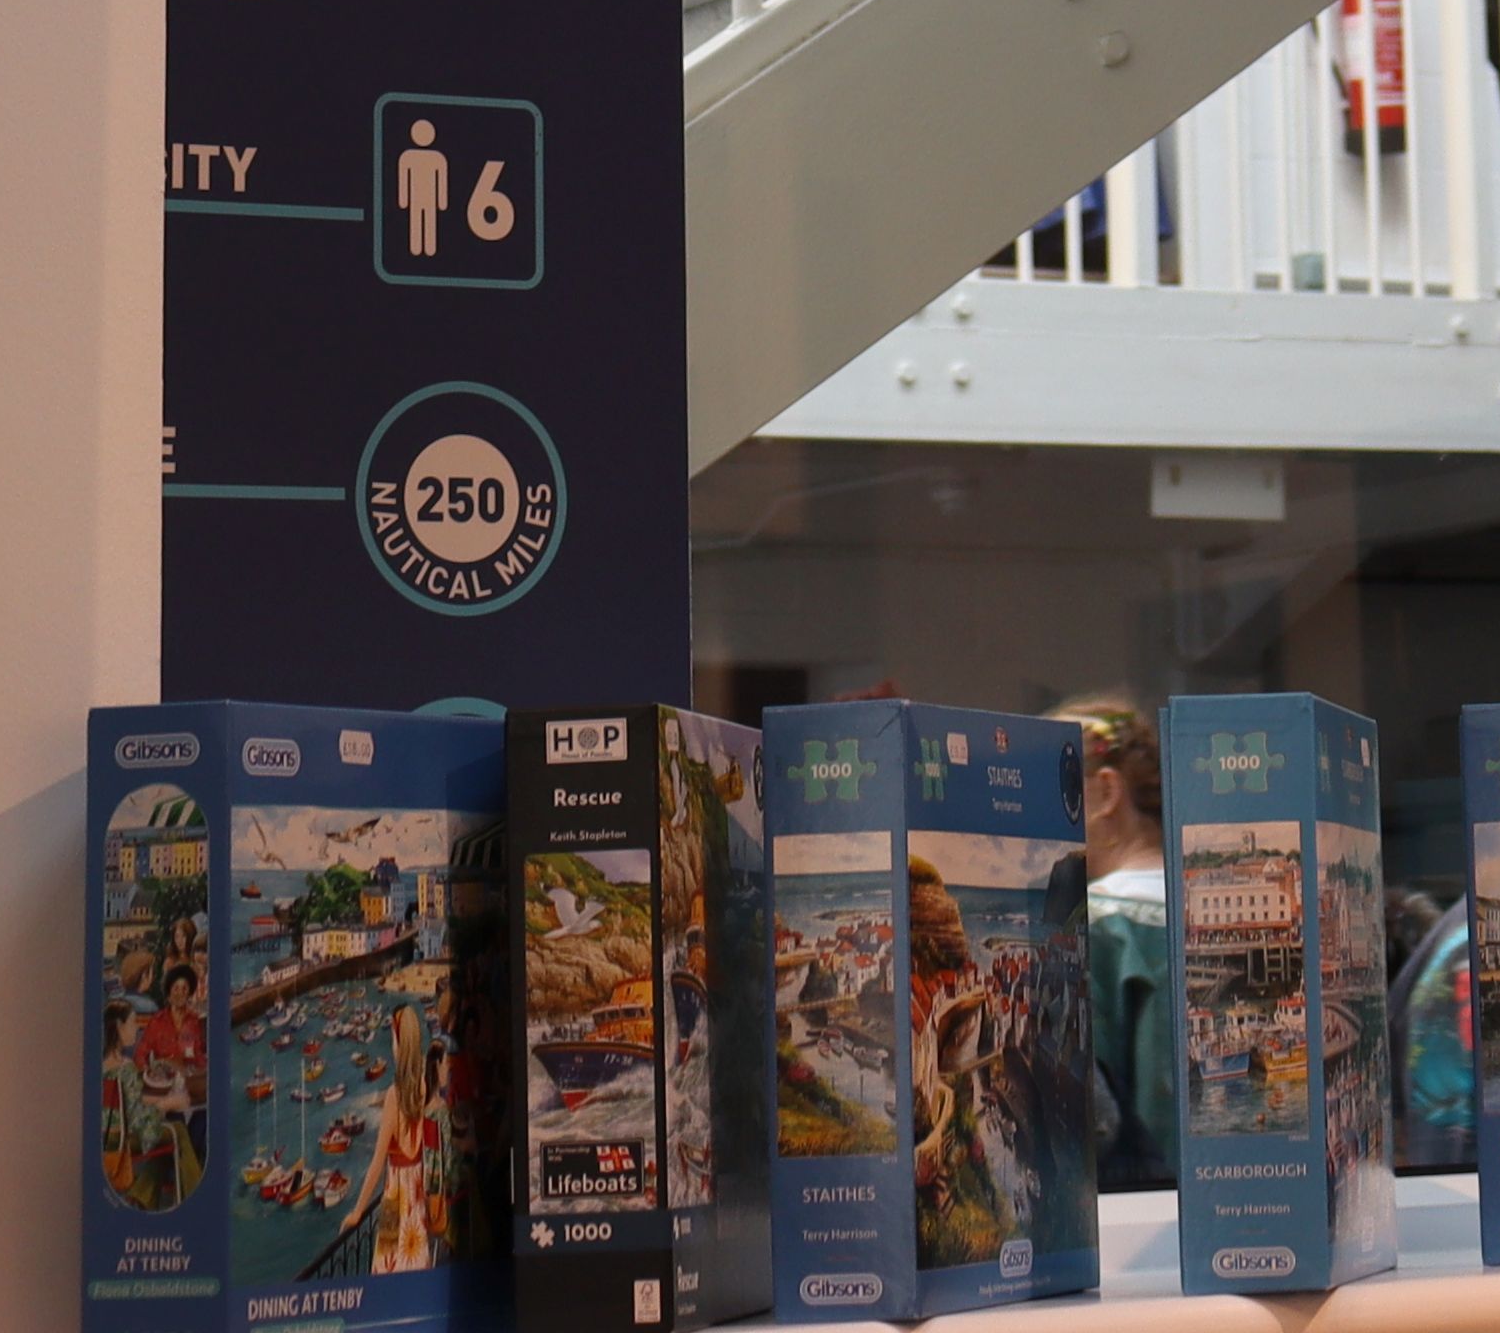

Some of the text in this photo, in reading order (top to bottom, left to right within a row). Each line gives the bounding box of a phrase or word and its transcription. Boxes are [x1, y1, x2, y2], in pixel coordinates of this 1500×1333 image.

[165, 143, 258, 193] ITY
[466, 160, 515, 241] 6
[417, 476, 504, 523] 250
[371, 481, 552, 599] NAUTICAL MILES
[122, 741, 192, 761] Gibsons
[248, 745, 296, 768] Gibsons
[810, 762, 853, 780] 1000
[1218, 754, 1261, 770] 1000
[553, 788, 623, 808] Rescue
[550, 828, 627, 843] Keith Stapleton
[1195, 1164, 1308, 1180] SCARBOROUGH
[547, 1173, 638, 1195] Lifeboats
[802, 1186, 877, 1204] STAITHES
[1215, 1202, 1291, 1218] Terry Harrison
[564, 1222, 612, 1243] 1000
[802, 1228, 878, 1243] Terry Harrison
[124, 1236, 183, 1253] DINING
[116, 1255, 191, 1273] AT TENBY
[1003, 1247, 1031, 1270] Gibsons
[1219, 1253, 1289, 1271] Gibsons
[806, 1280, 875, 1298] Gibsons
[247, 1287, 364, 1322] DINING AT TENBY
